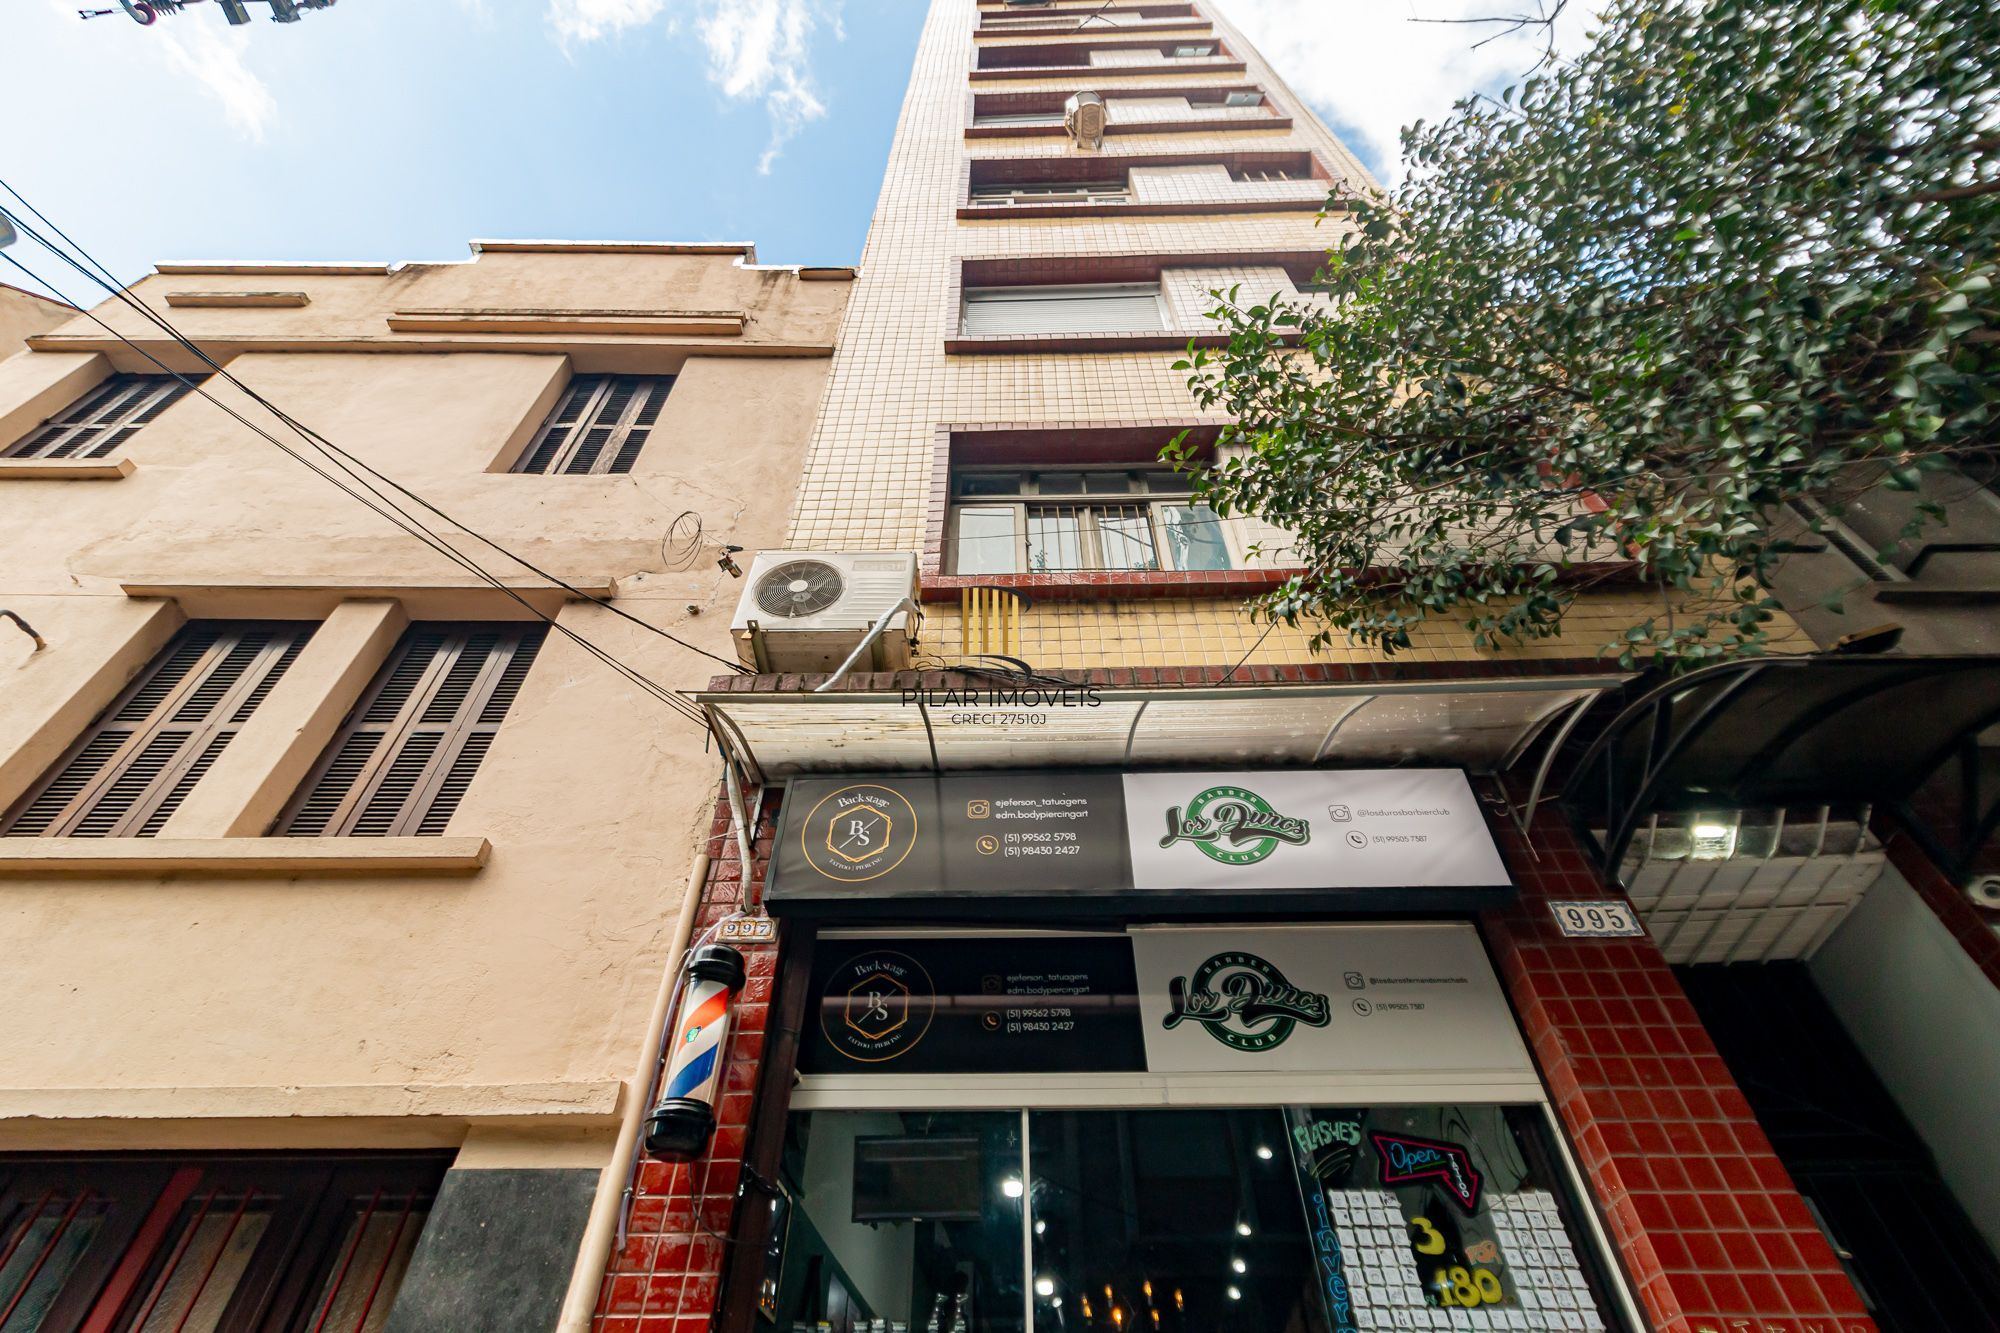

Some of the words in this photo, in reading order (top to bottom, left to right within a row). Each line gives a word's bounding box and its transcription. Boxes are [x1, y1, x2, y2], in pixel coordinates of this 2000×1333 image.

[1198, 789, 1258, 804] BARBER
[1159, 805, 1220, 848] Los
[1213, 802, 1311, 847] Duros
[1004, 833, 1020, 844] (51)
[1022, 833, 1051, 842] 99562
[1053, 832, 1076, 841] 5798
[1372, 834, 1386, 844] (51)
[1004, 846, 1020, 858] (51)
[1054, 845, 1080, 855] 2427
[1216, 851, 1262, 862] CLUB
[1567, 908, 1625, 929] 995
[727, 924, 767, 934] 997
[1204, 956, 1270, 974] BARBER
[1162, 976, 1231, 1030] Los
[1222, 972, 1331, 1028] Duros
[1006, 1009, 1021, 1020] (51)
[1022, 1009, 1049, 1018] 99562
[1050, 1008, 1071, 1017] 5798
[1007, 1022, 1021, 1033] (51)
[1052, 1021, 1075, 1031] 2427
[1227, 1033, 1277, 1046] CLUB
[1294, 1120, 1361, 1154] FLASHES
[1391, 1142, 1441, 1174] Open
[1447, 1153, 1470, 1198] TATTOO
[1410, 1217, 1446, 1255] 3
[1435, 1265, 1503, 1308] 180
